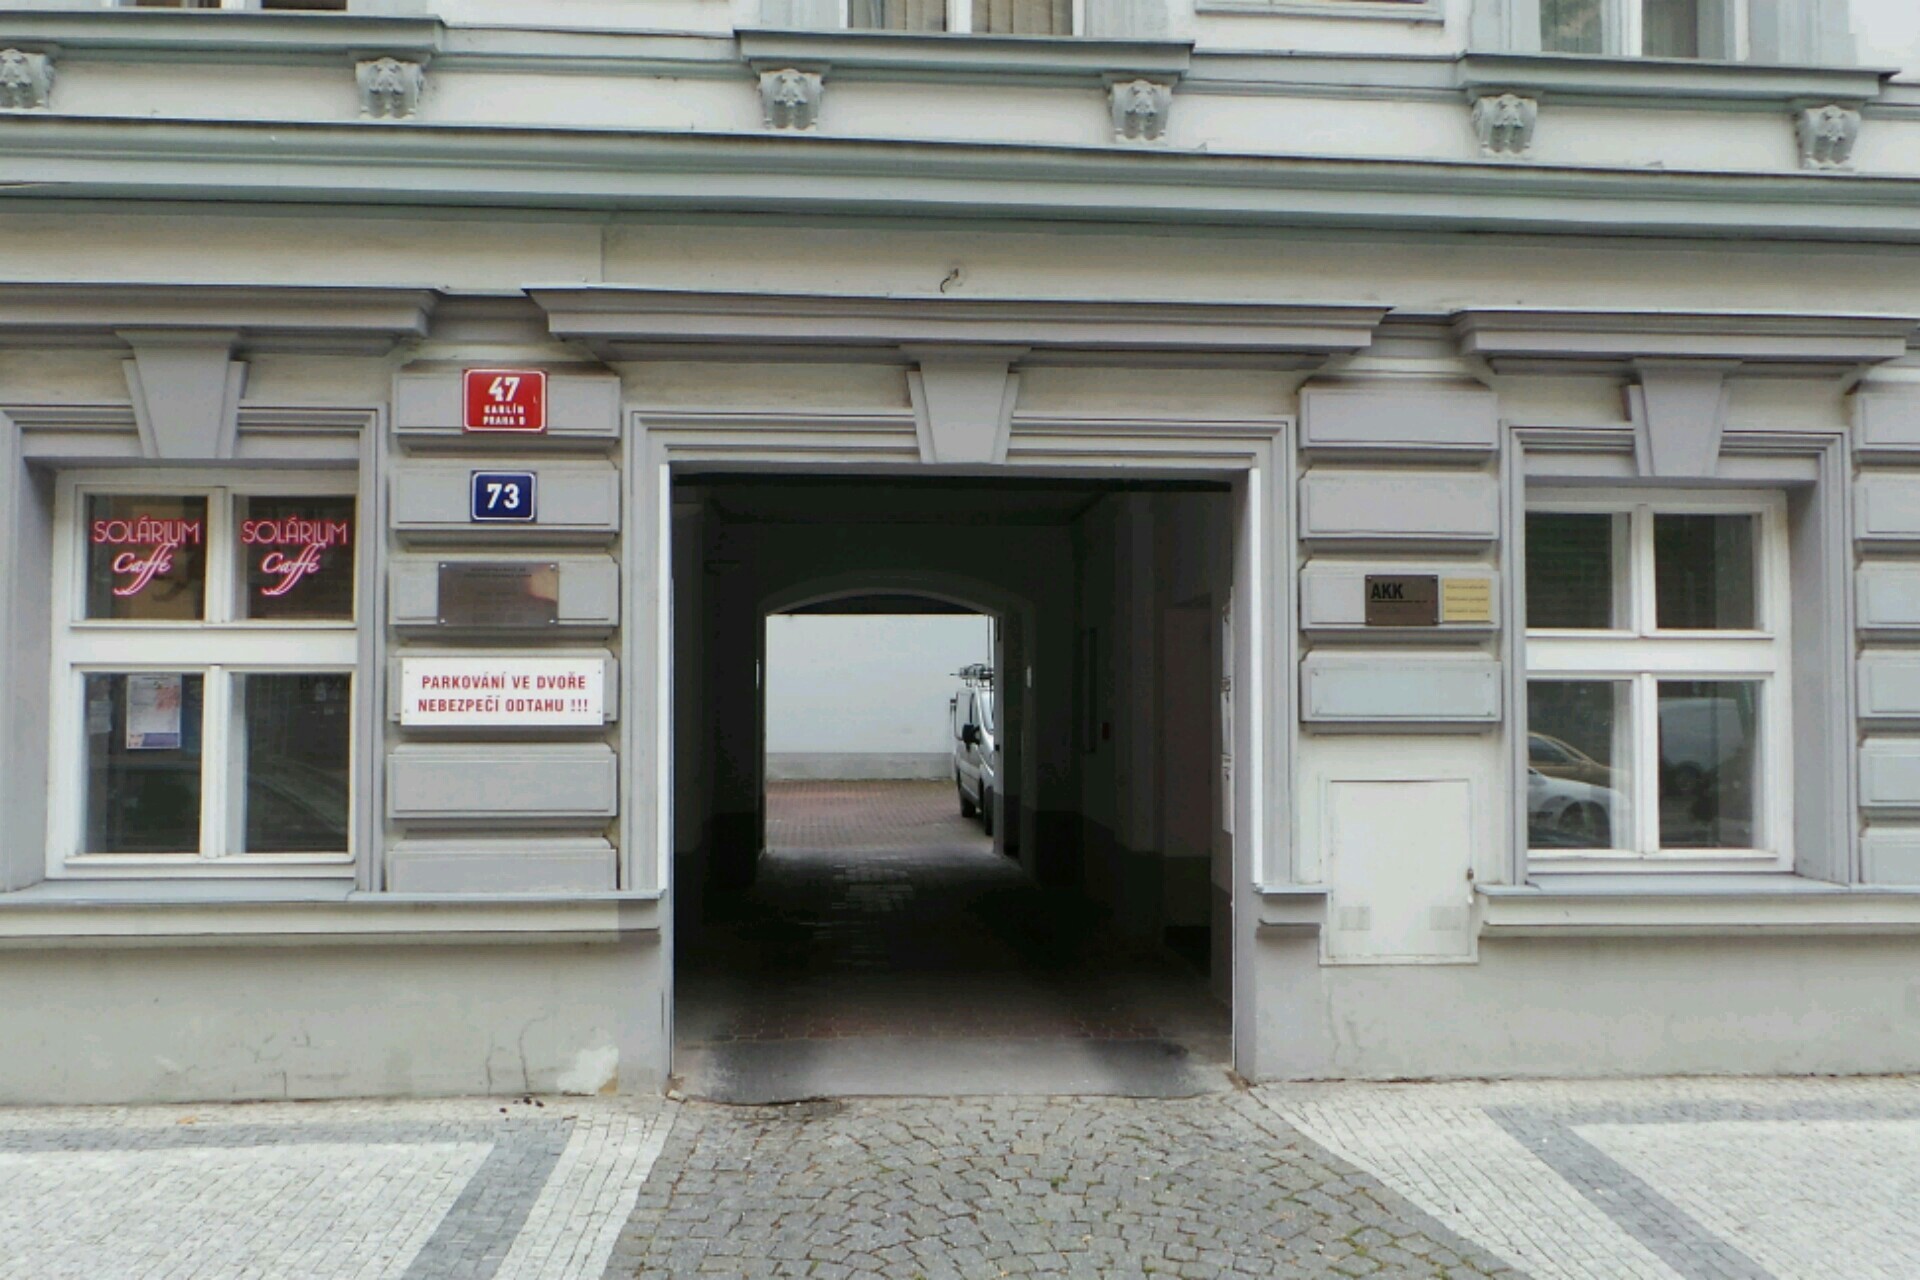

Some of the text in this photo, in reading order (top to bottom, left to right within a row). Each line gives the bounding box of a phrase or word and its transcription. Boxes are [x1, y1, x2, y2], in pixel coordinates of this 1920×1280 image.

[488, 376, 520, 402] 47
[487, 483, 519, 509] 73
[94, 515, 200, 543] SOLÁRIUM
[242, 516, 347, 544] SOLÁRIUM
[113, 542, 178, 595] Caffé
[261, 542, 327, 595] Caffé
[1371, 582, 1404, 599] AKK
[422, 671, 586, 689] PARKOVÁNÍ VE DVOŘE
[418, 695, 588, 713] NEBEZPEČÍ ODTAHU !!!
